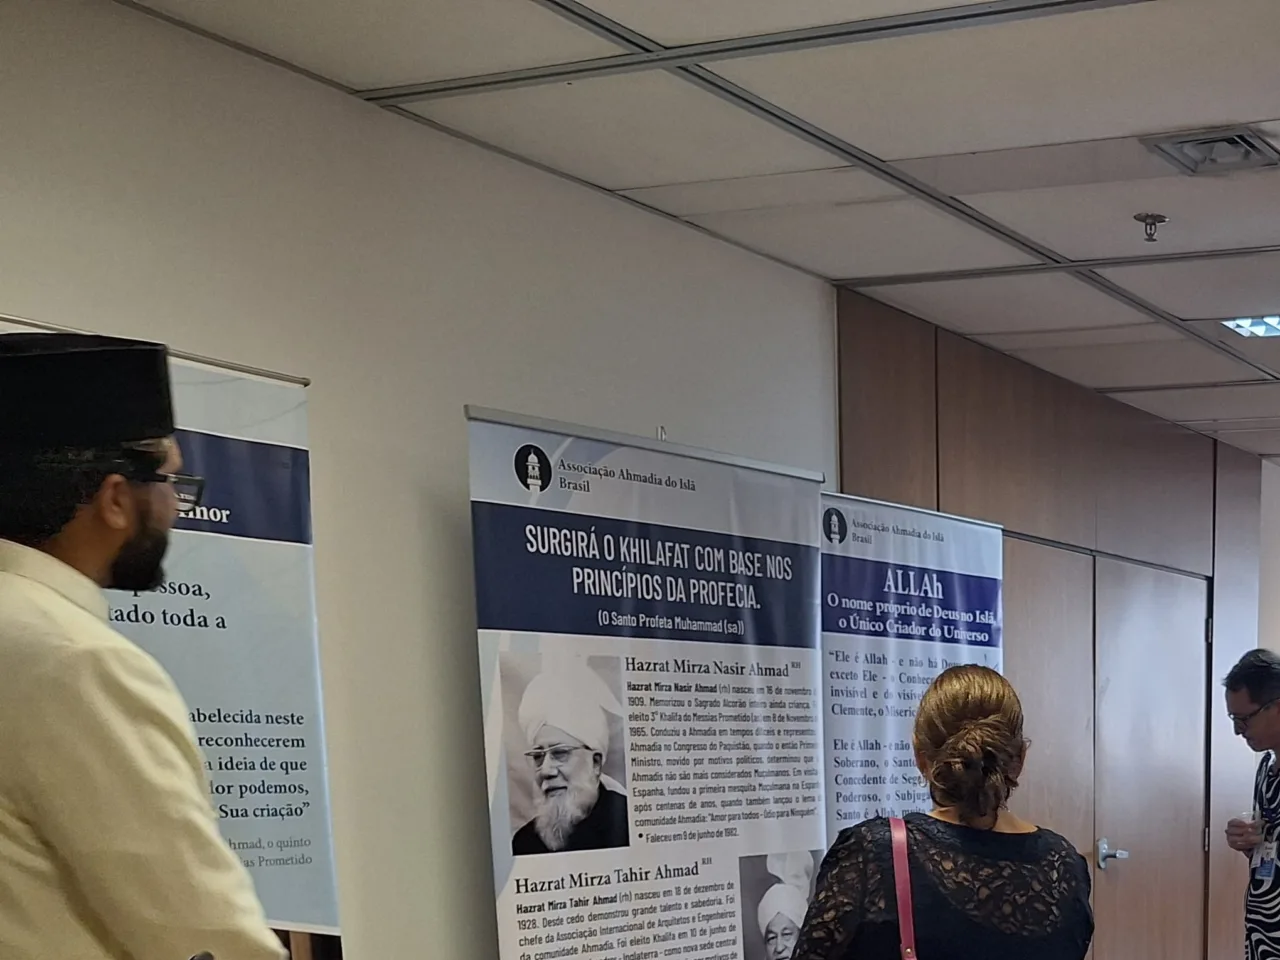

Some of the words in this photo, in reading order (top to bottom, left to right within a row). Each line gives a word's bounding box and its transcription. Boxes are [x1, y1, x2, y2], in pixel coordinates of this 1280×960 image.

[558, 459, 615, 479] Associação
[618, 468, 662, 486] Ahmadia
[664, 475, 677, 488] do
[679, 478, 695, 491] Islã
[559, 477, 590, 492] Brasil
[852, 518, 889, 532] Associação
[892, 525, 921, 538] Ahmadia
[922, 529, 930, 539] do
[932, 532, 944, 542] Islã
[852, 532, 872, 544] Brasil
[525, 524, 600, 559] SURGIRÁ
[604, 534, 615, 561] O
[619, 536, 690, 569] KHILAFAT
[695, 545, 723, 573] COM
[729, 549, 762, 578] BASE
[765, 553, 792, 580] NOS
[572, 566, 662, 600] PRINCÍPIOS
[666, 576, 686, 603] DA
[689, 579, 761, 609] PROFECIA.
[883, 568, 943, 599] ALLAh
[827, 593, 838, 607] O
[841, 596, 873, 611] nome
[875, 599, 917, 618] próprio
[918, 603, 931, 617] de
[932, 605, 958, 620] Deus
[960, 610, 973, 622] no
[108, 604, 155, 624] tado
[161, 608, 209, 628] toda
[215, 616, 227, 629] a
[598, 609, 609, 626] (O
[610, 611, 637, 627] Santo
[639, 613, 672, 629] Profeta
[674, 616, 722, 632] Muhammad
[723, 619, 744, 635] (sa))
[838, 618, 846, 628] o
[849, 613, 883, 632] Único
[885, 618, 927, 636] Criador
[928, 623, 941, 637] do
[943, 625, 988, 642] Universo
[625, 657, 669, 672] Hazrat
[673, 659, 710, 674] Mirza
[713, 661, 745, 675] Nasir
[749, 662, 789, 677] Ahmad
[863, 653, 888, 665] Allah
[899, 658, 904, 666] e
[909, 657, 923, 667] não
[830, 670, 858, 680] exceto
[862, 670, 878, 682] Ele
[872, 690, 878, 699] e
[189, 708, 261, 723] abelecida
[265, 713, 305, 725] neste
[878, 708, 884, 716] o
[198, 732, 306, 748] reconhecerem
[833, 739, 849, 750] Ele
[894, 739, 910, 751] não
[218, 757, 256, 771] ideia
[259, 757, 276, 771] de
[280, 760, 307, 775] que
[833, 756, 879, 769] Soberano,
[835, 774, 887, 786] Concedente
[889, 774, 899, 785] de
[239, 780, 309, 798] podemos,
[835, 791, 881, 803] Poderoso,
[218, 804, 249, 819] Sua
[228, 838, 265, 850] hmad,
[267, 840, 274, 848] o
[276, 837, 311, 851] quinto
[258, 854, 313, 867] Prometido
[515, 877, 565, 894] Hazrat
[569, 872, 611, 888] Mirza
[614, 867, 650, 884] Tahir
[654, 861, 699, 880] Ahmad
[516, 903, 545, 914] Hazrat
[547, 899, 567, 910] Mirza
[569, 896, 590, 908] Tahir
[592, 893, 617, 905] Ahmad
[634, 890, 660, 900] nasceu
[662, 888, 672, 897] em
[683, 885, 691, 894] de
[726, 880, 734, 890] de
[542, 915, 563, 928] Desde
[566, 913, 584, 924] cedo
[587, 908, 629, 922] demonstrou
[631, 904, 657, 918] grande
[659, 901, 682, 912] talento
[725, 895, 735, 904] Foi
